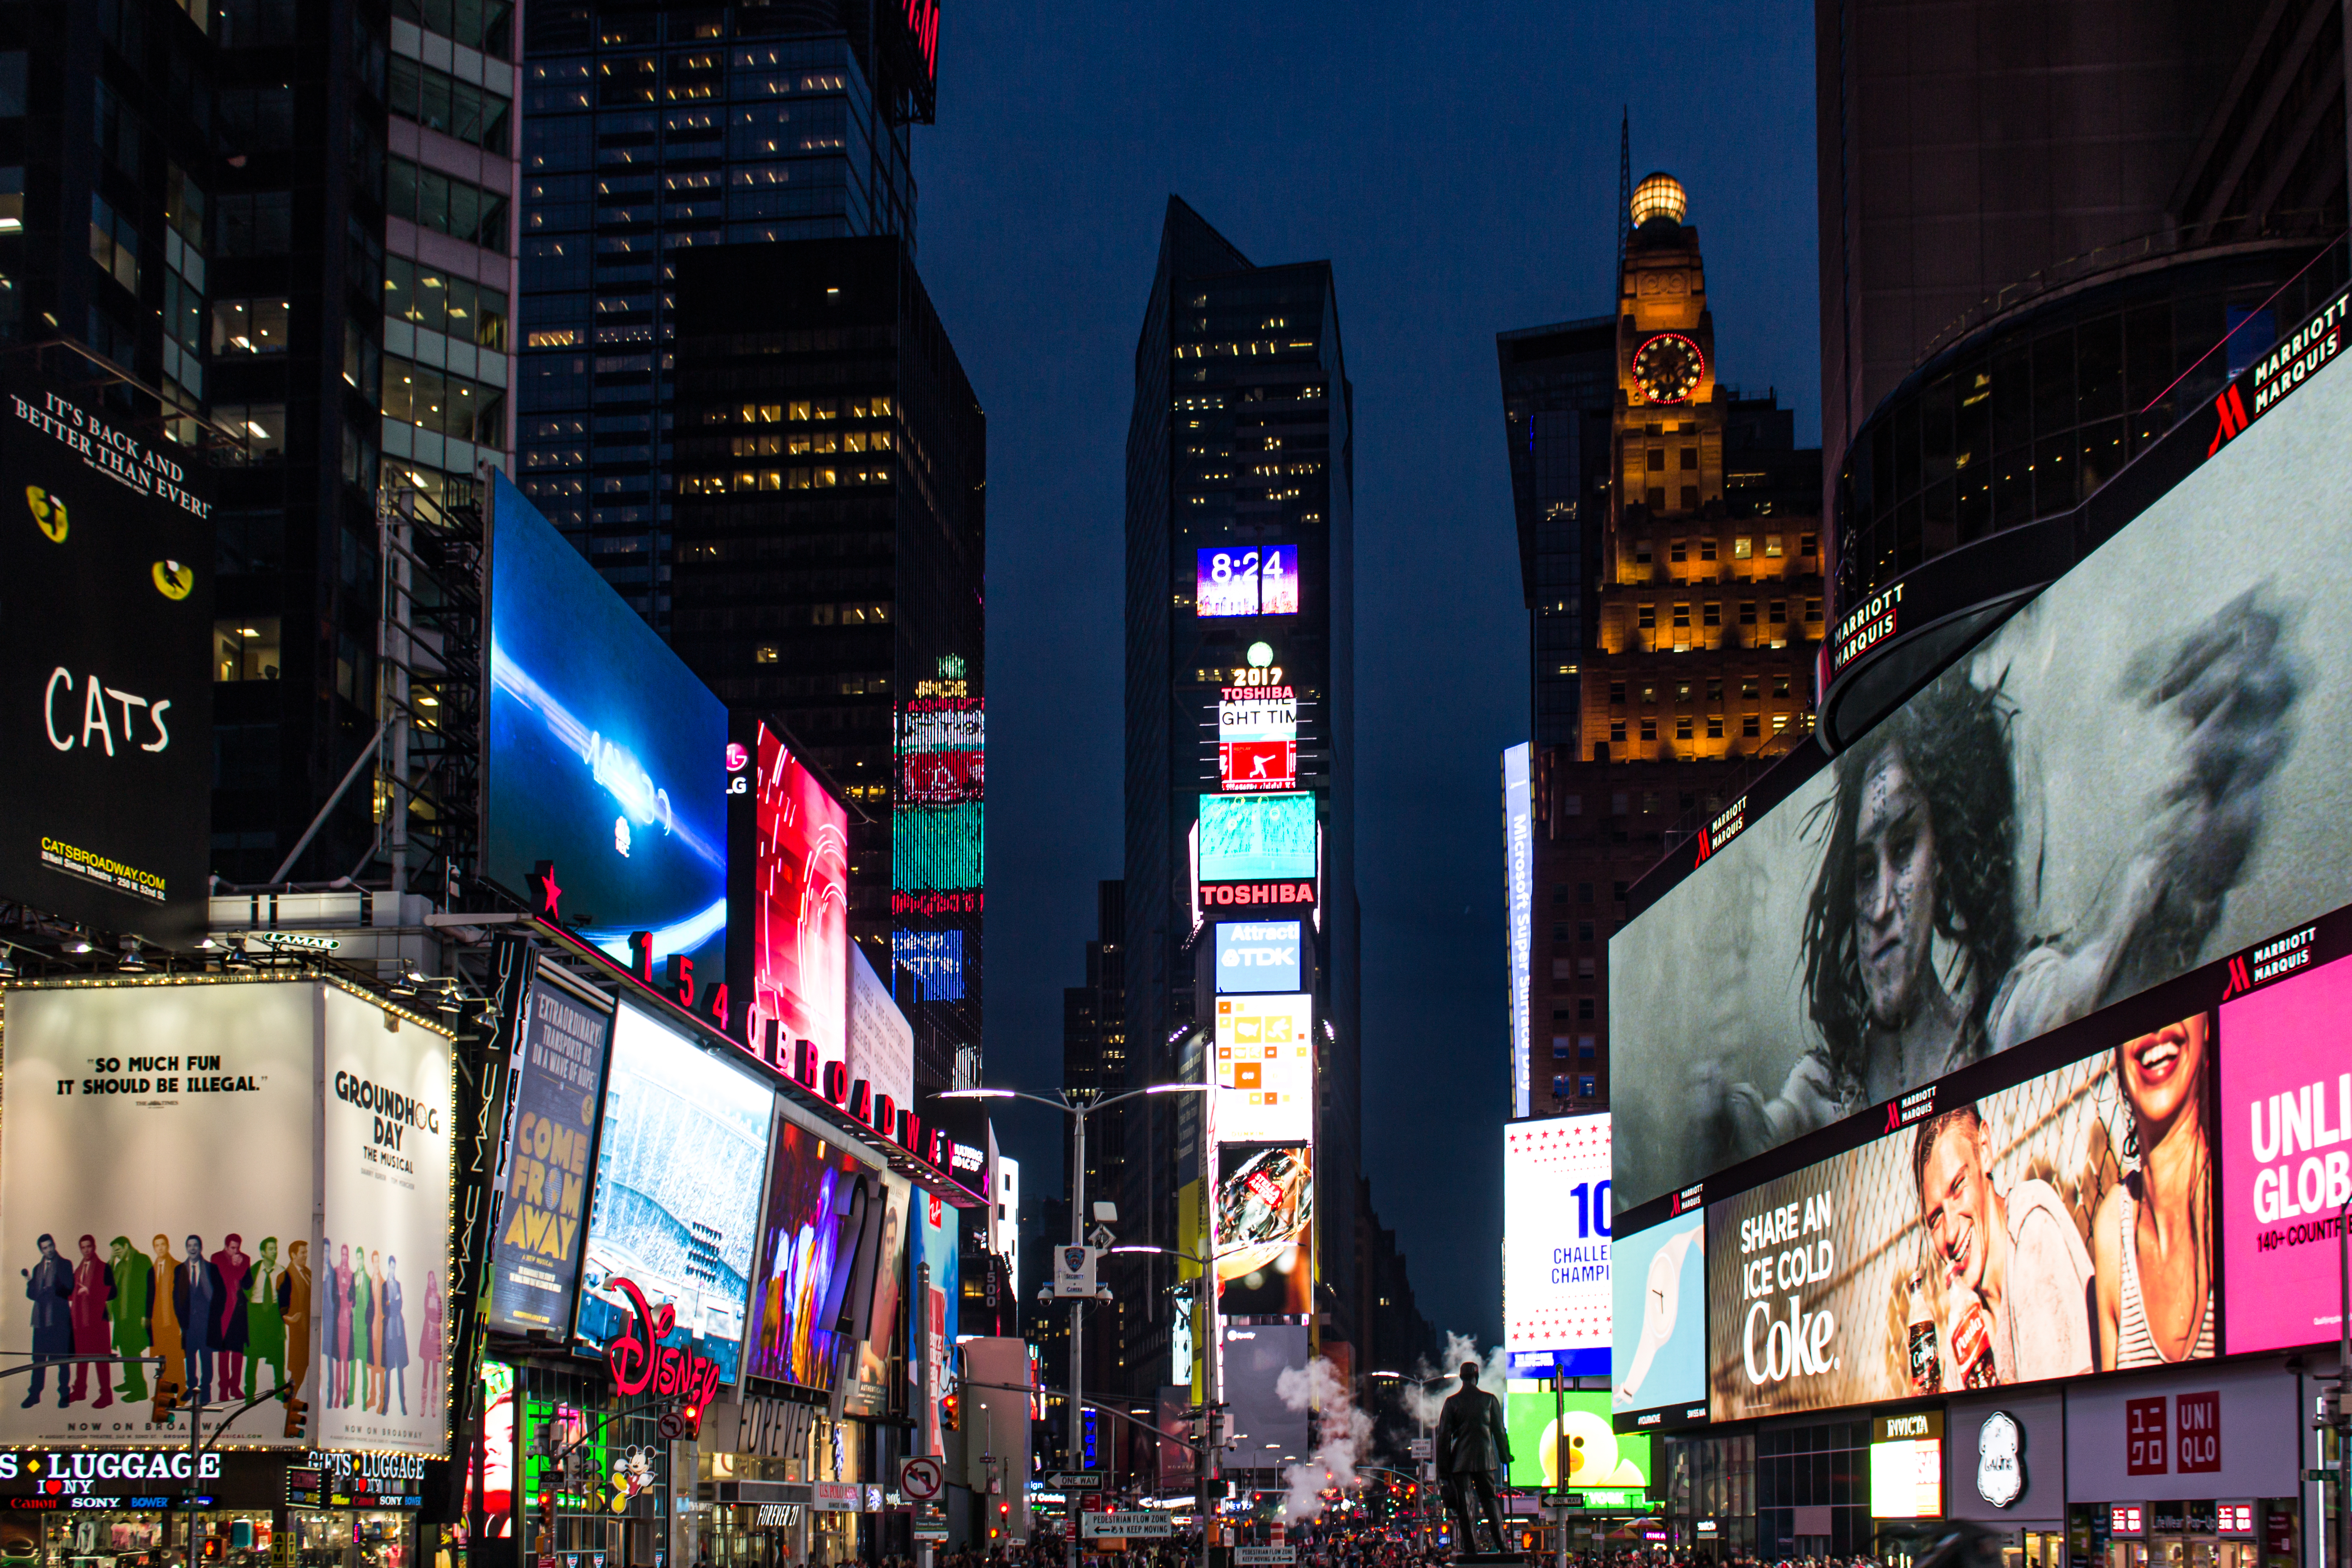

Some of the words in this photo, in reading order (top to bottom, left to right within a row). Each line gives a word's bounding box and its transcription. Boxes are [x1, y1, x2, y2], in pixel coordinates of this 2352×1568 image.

[2255, 293, 2349, 386] MARRIOTT
[2255, 333, 2337, 413] MARQUIS
[46, 392, 83, 427] IT'S
[88, 415, 139, 459] BACK
[143, 450, 184, 482] AND
[97, 444, 151, 489] THAN
[1211, 551, 1283, 583] 8:24
[1835, 583, 1904, 647] MARRIOTT
[1835, 614, 1894, 671] MARQUIS
[1234, 668, 1283, 686] 2017
[1221, 686, 1294, 701] TOSHIBA
[44, 666, 172, 757] CATS
[1222, 711, 1260, 725] GHT
[1712, 795, 1747, 833] MARRIOTT
[1712, 818, 1743, 849] MARQUIS
[42, 837, 166, 890] CATSBROADWAY.COM
[1514, 814, 1528, 910] Microsoft
[1200, 884, 1314, 905] TOSHIBA
[270, 933, 333, 948] LAMAR
[1515, 913, 1530, 971] Super
[2254, 927, 2316, 963] MARRIOTT
[1238, 947, 1295, 966] TDK
[2254, 950, 2309, 982] MARQUIS
[544, 1024, 580, 1063] TRANSPORTS
[583, 1046, 592, 1067] US
[128, 1056, 180, 1072] MUCH
[186, 1055, 221, 1071] FUN
[532, 1044, 543, 1065] ON
[543, 1049, 549, 1069] A
[549, 1051, 568, 1079] WAVE
[568, 1061, 577, 1082] OF
[57, 1080, 74, 1095] IT
[83, 1078, 151, 1094] SHOULD
[157, 1077, 179, 1093] BE
[1902, 1086, 1936, 1108] MARRIOTT
[335, 1069, 440, 1135] GROUNDHOG
[1902, 1102, 1932, 1123] MARQUIS
[2251, 1073, 2352, 1163] UNLI
[373, 1115, 405, 1152] DAY
[519, 1111, 588, 1175] COME
[363, 1145, 377, 1162] THE
[381, 1152, 413, 1174] MUSICAL
[511, 1155, 583, 1219] FROM
[1249, 1180, 1276, 1205] ARTOIS
[1255, 1173, 1279, 1200] STELLA
[1681, 1183, 1703, 1199] MARRIOTT
[2254, 1151, 2352, 1224] GLOB
[1681, 1195, 1700, 1210] MARQUIS
[504, 1202, 578, 1261] AWAY
[1740, 1201, 1799, 1254] SHARE
[1802, 1191, 1832, 1235] AN
[1554, 1245, 1612, 1264] CHALLE
[986, 1260, 996, 1308] 1500
[1743, 1255, 1774, 1300] ICE
[1777, 1239, 1835, 1291] COLD
[68, 1422, 102, 1431] NOW
[112, 1422, 133, 1431] ON
[145, 1422, 233, 1431] BROAWAY
[737, 1396, 815, 1460] FOREVER
[1638, 1413, 1661, 1425] #YOURMOVE
[1886, 1415, 1928, 1438] INVICTA
[2181, 1402, 2212, 1431] UNI
[344, 1425, 362, 1434] NOW
[367, 1426, 377, 1435] ON
[382, 1428, 423, 1440] BROADWAY
[47, 1453, 220, 1479] LUGGAGE
[2182, 1435, 2216, 1468] QLO
[362, 1454, 425, 1480] LUGGAGE
[37, 1480, 46, 1494] I
[62, 1480, 94, 1494] NY
[331, 1493, 351, 1505] Nikon
[379, 1496, 402, 1505] SONY
[368, 1479, 382, 1493] NY
[819, 1484, 828, 1498] U.S.
[830, 1485, 843, 1499] POLO
[1588, 1492, 1624, 1505] YORK
[10, 1498, 58, 1509] Canon
[71, 1498, 120, 1508] SONY
[131, 1497, 169, 1508] BOWER
[757, 1504, 791, 1527] FOREVER
[789, 1505, 799, 1527] 21
[1093, 1515, 1132, 1524] PEDESTRIAN
[1133, 1515, 1150, 1523] FLOW
[1151, 1514, 1167, 1523] ZONE
[1127, 1526, 1142, 1534] KEEP
[1144, 1525, 1168, 1534] MOVING
[274, 1534, 284, 1563] ATM
